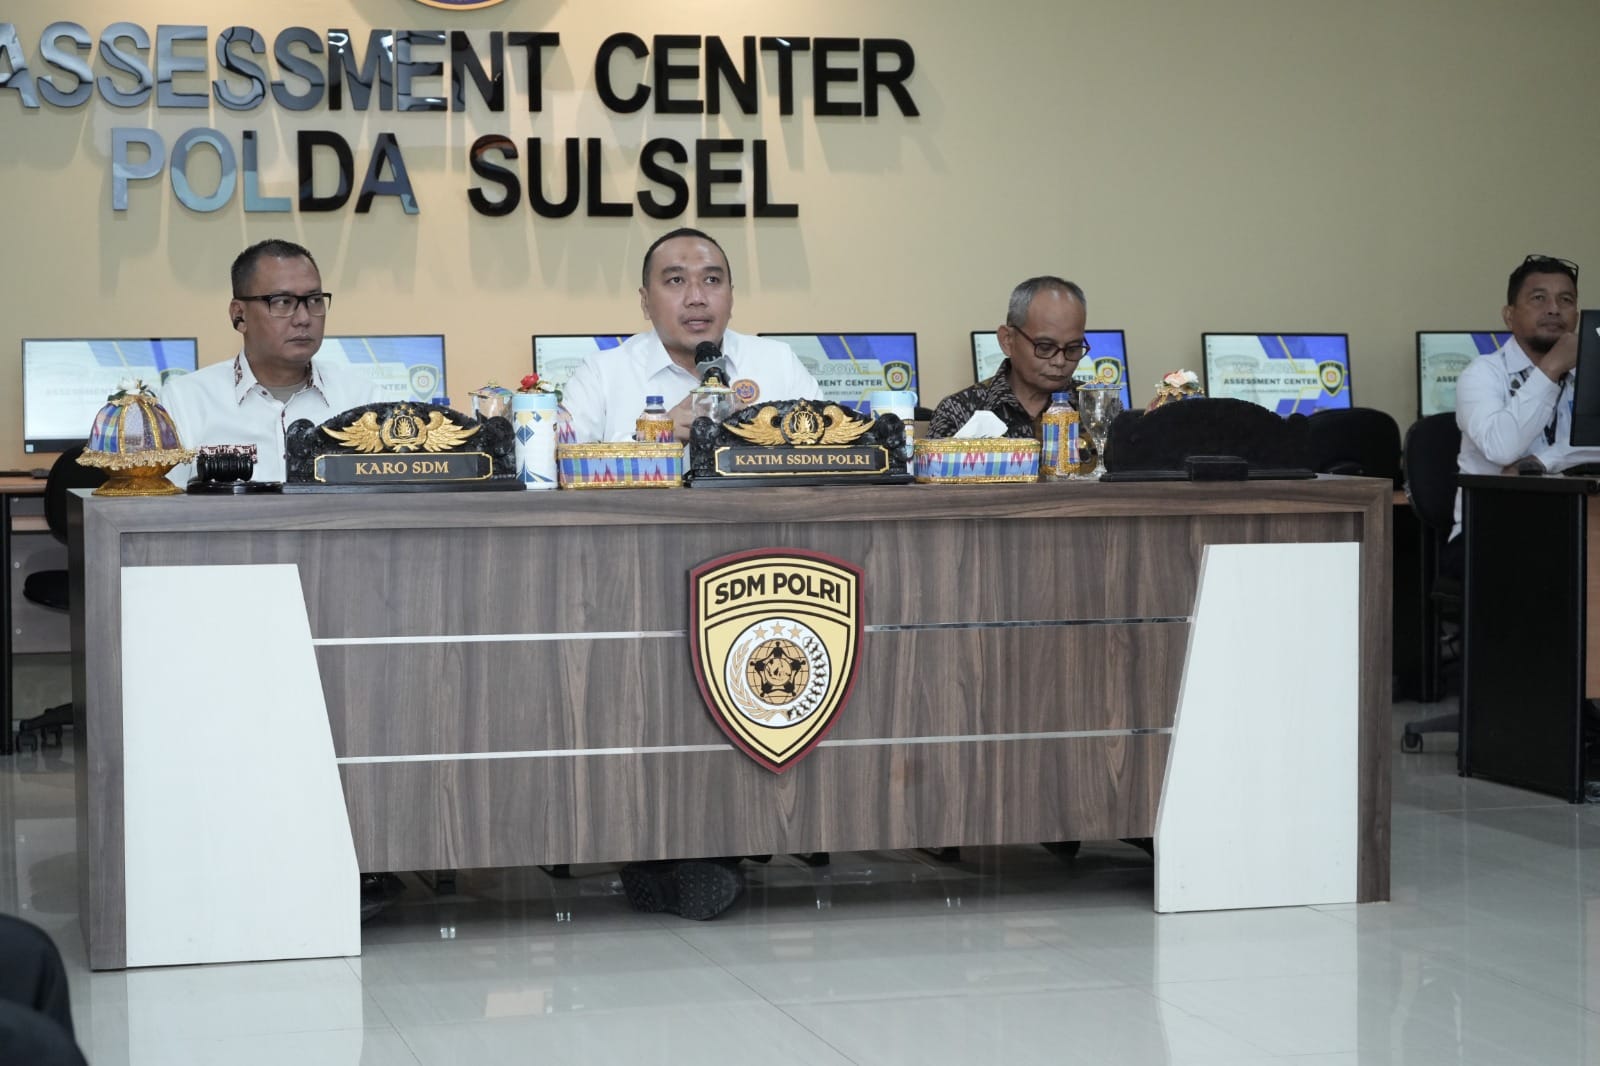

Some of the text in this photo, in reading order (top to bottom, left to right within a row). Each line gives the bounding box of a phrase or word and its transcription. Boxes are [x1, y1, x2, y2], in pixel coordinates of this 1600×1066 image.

[0, 22, 920, 117] ASSESSMENT CENTER
[111, 127, 799, 219] POLDA SULSEL
[845, 379, 883, 387] CENTER
[1223, 378, 1319, 386] ASSESSMENT CENTER
[735, 454, 871, 465] KATIM SSDM POLRI
[355, 461, 449, 475] KARO SDM
[714, 573, 841, 604] SDM POLRI
